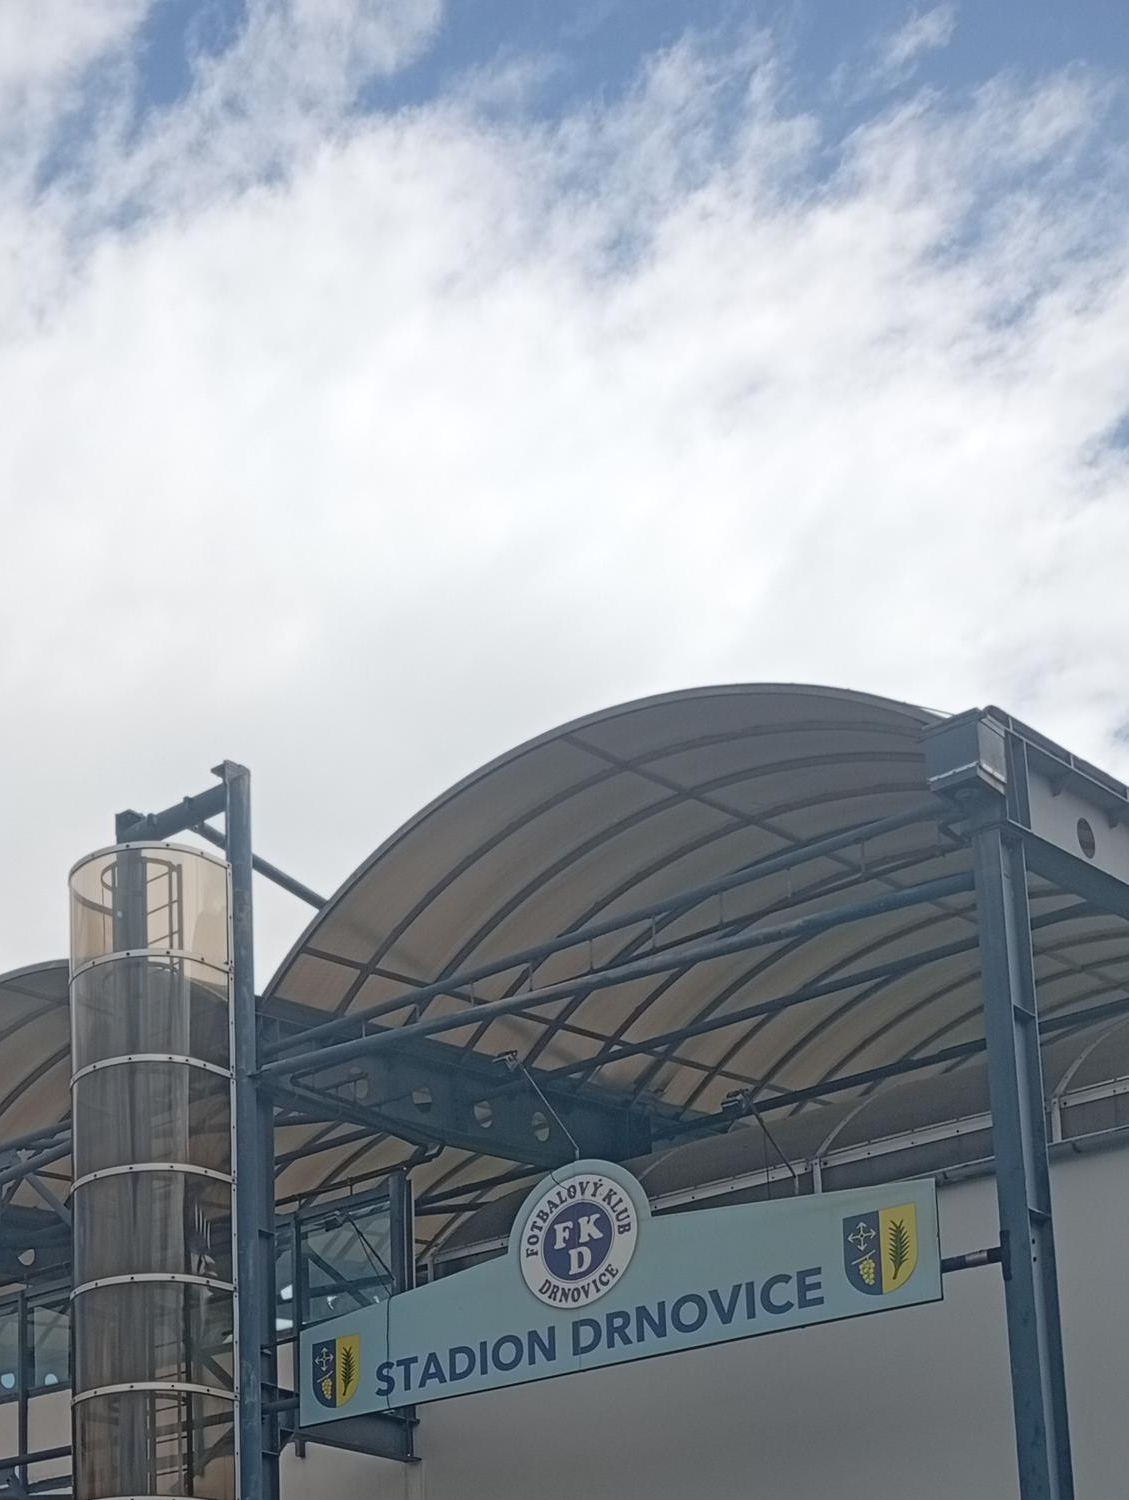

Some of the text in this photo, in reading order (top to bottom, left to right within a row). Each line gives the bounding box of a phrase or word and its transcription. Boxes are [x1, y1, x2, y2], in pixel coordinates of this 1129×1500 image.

[526, 1178, 632, 1258] FOTBALOVÝ KLUB
[538, 1263, 619, 1303] DRNOVICE
[374, 1265, 825, 1397] STADION DRNOVICE
